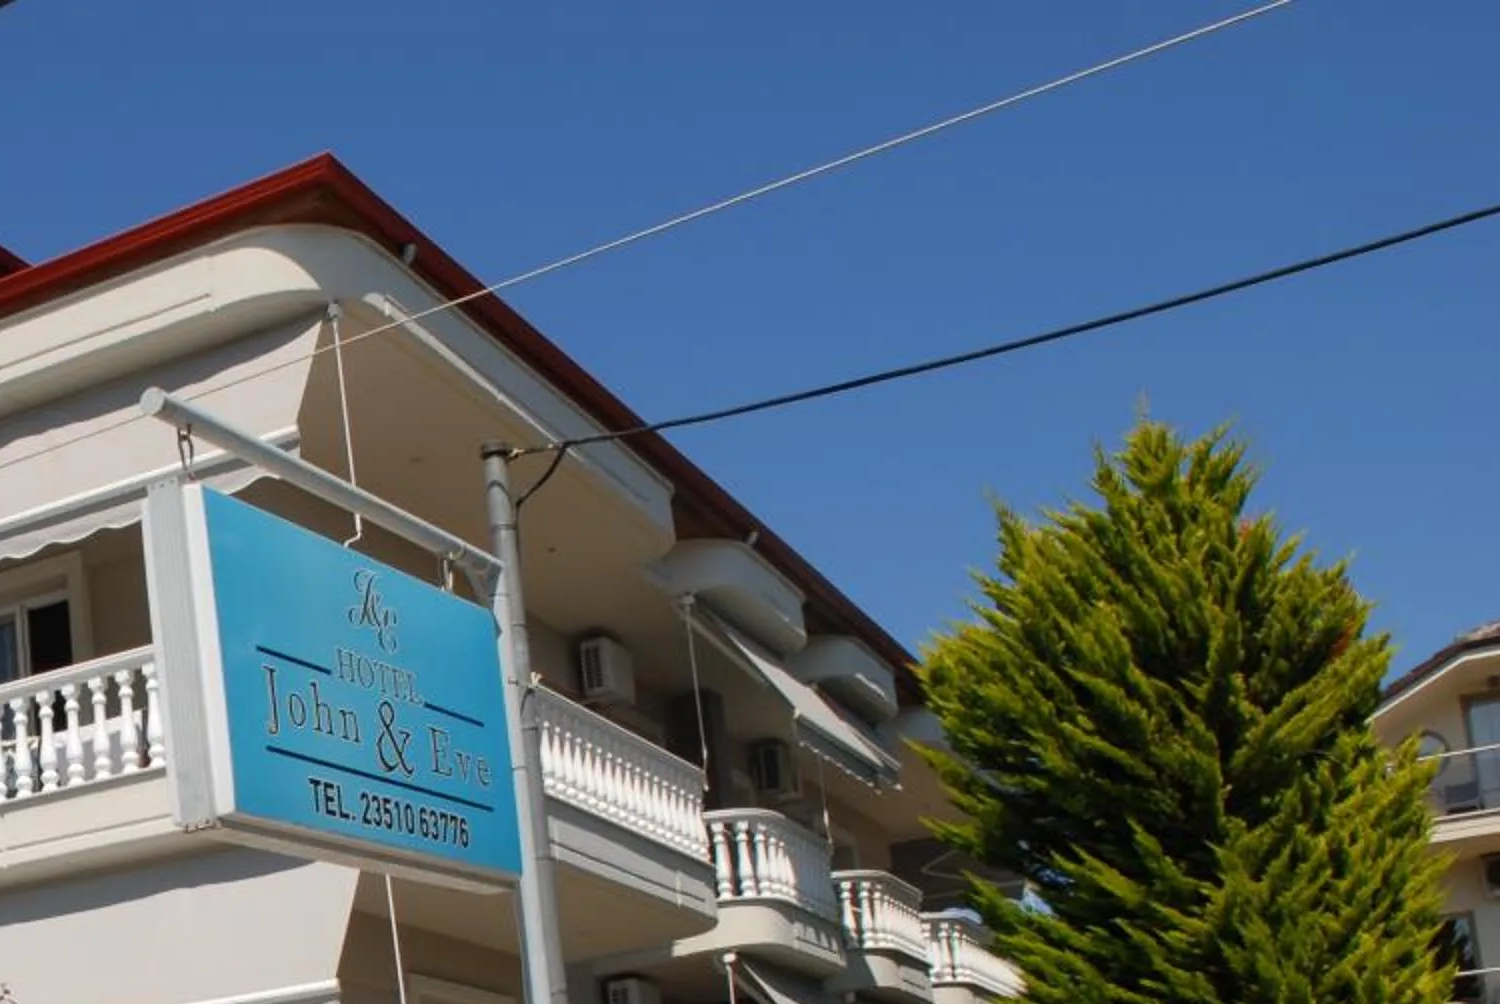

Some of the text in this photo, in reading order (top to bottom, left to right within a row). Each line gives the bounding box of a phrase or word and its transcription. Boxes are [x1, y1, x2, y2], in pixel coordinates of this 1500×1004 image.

[336, 648, 423, 703] HOTEL
[263, 665, 492, 786] John & Eve
[308, 778, 469, 849] TEL. 23510 63776
